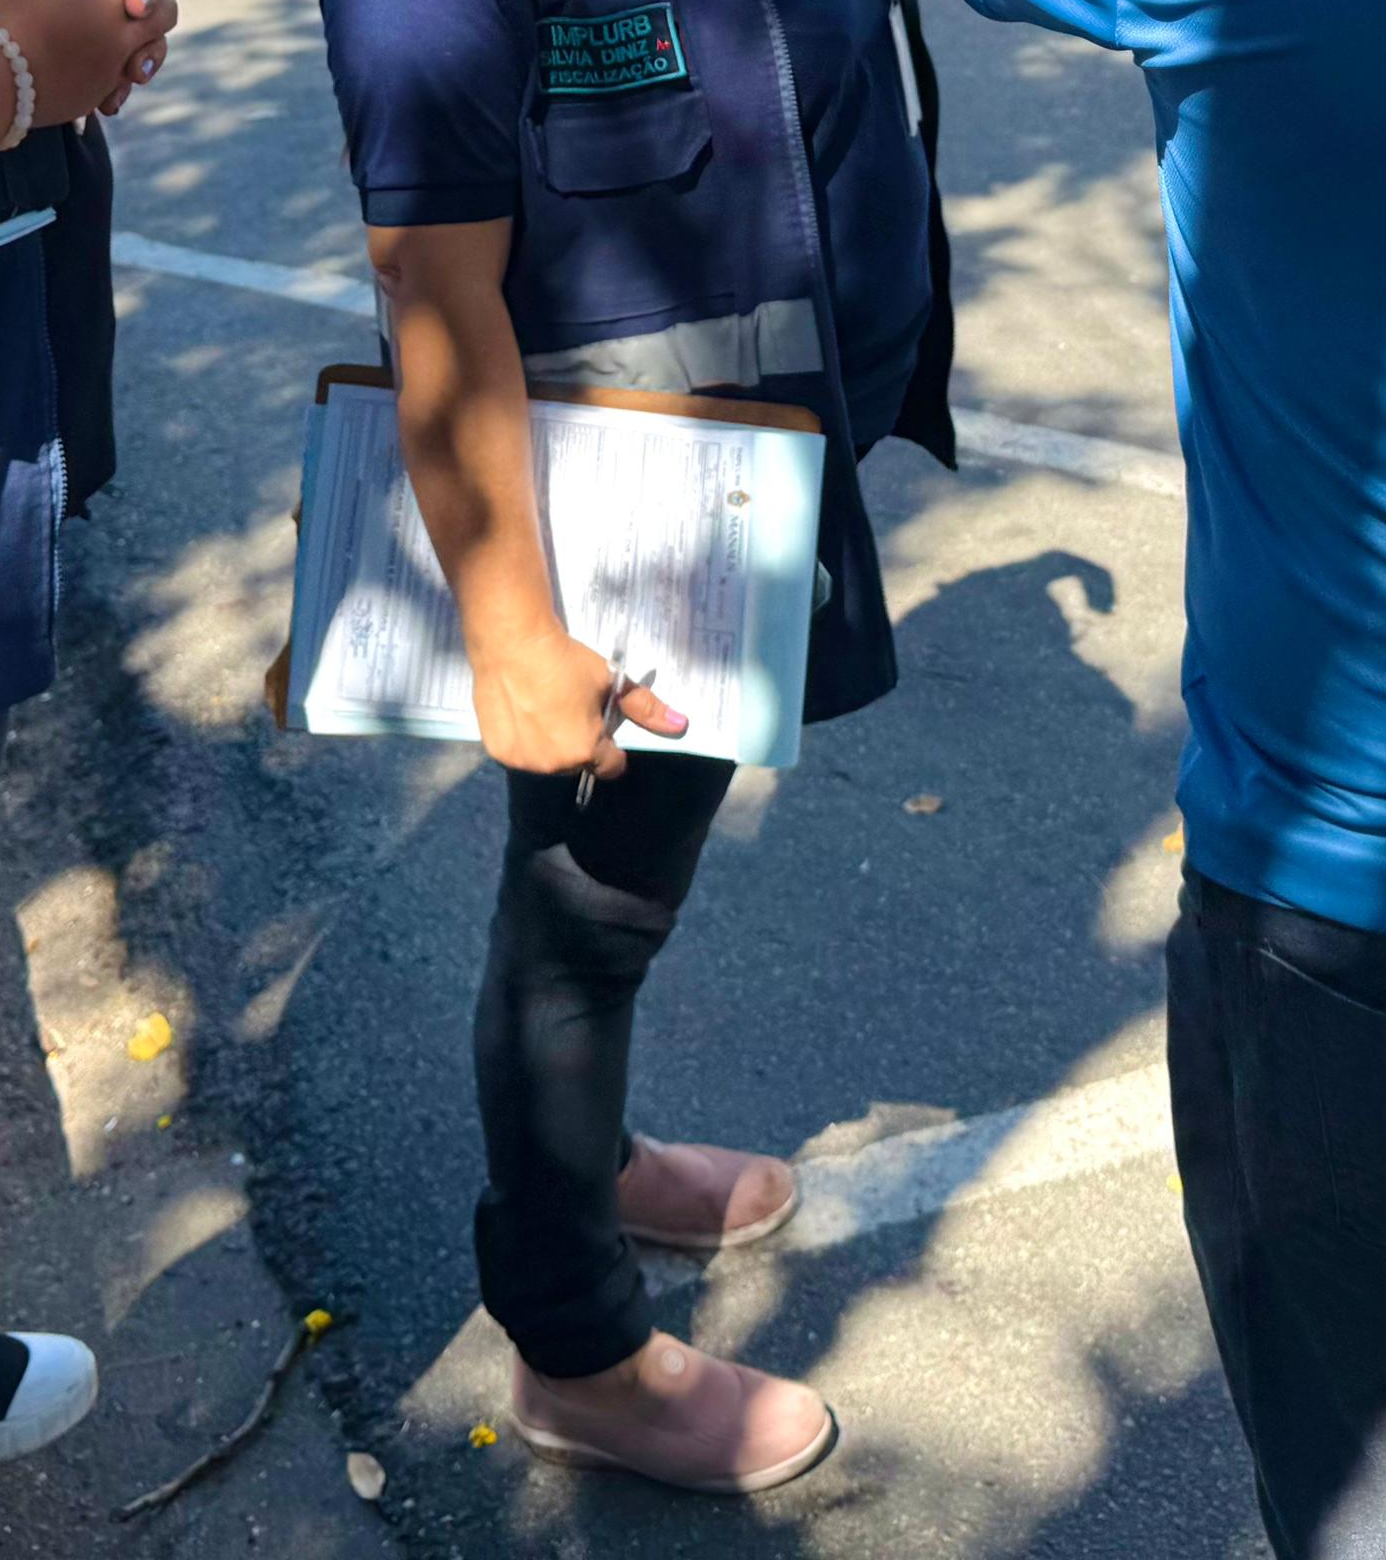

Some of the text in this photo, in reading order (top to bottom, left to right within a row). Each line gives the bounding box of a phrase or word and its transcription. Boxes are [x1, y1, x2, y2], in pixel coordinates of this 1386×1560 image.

[550, 14, 652, 47] IMPLURB
[541, 48, 593, 66] SILVIA
[601, 39, 649, 65] DINIZ
[549, 56, 668, 85] FISCALIZAÇÃO
